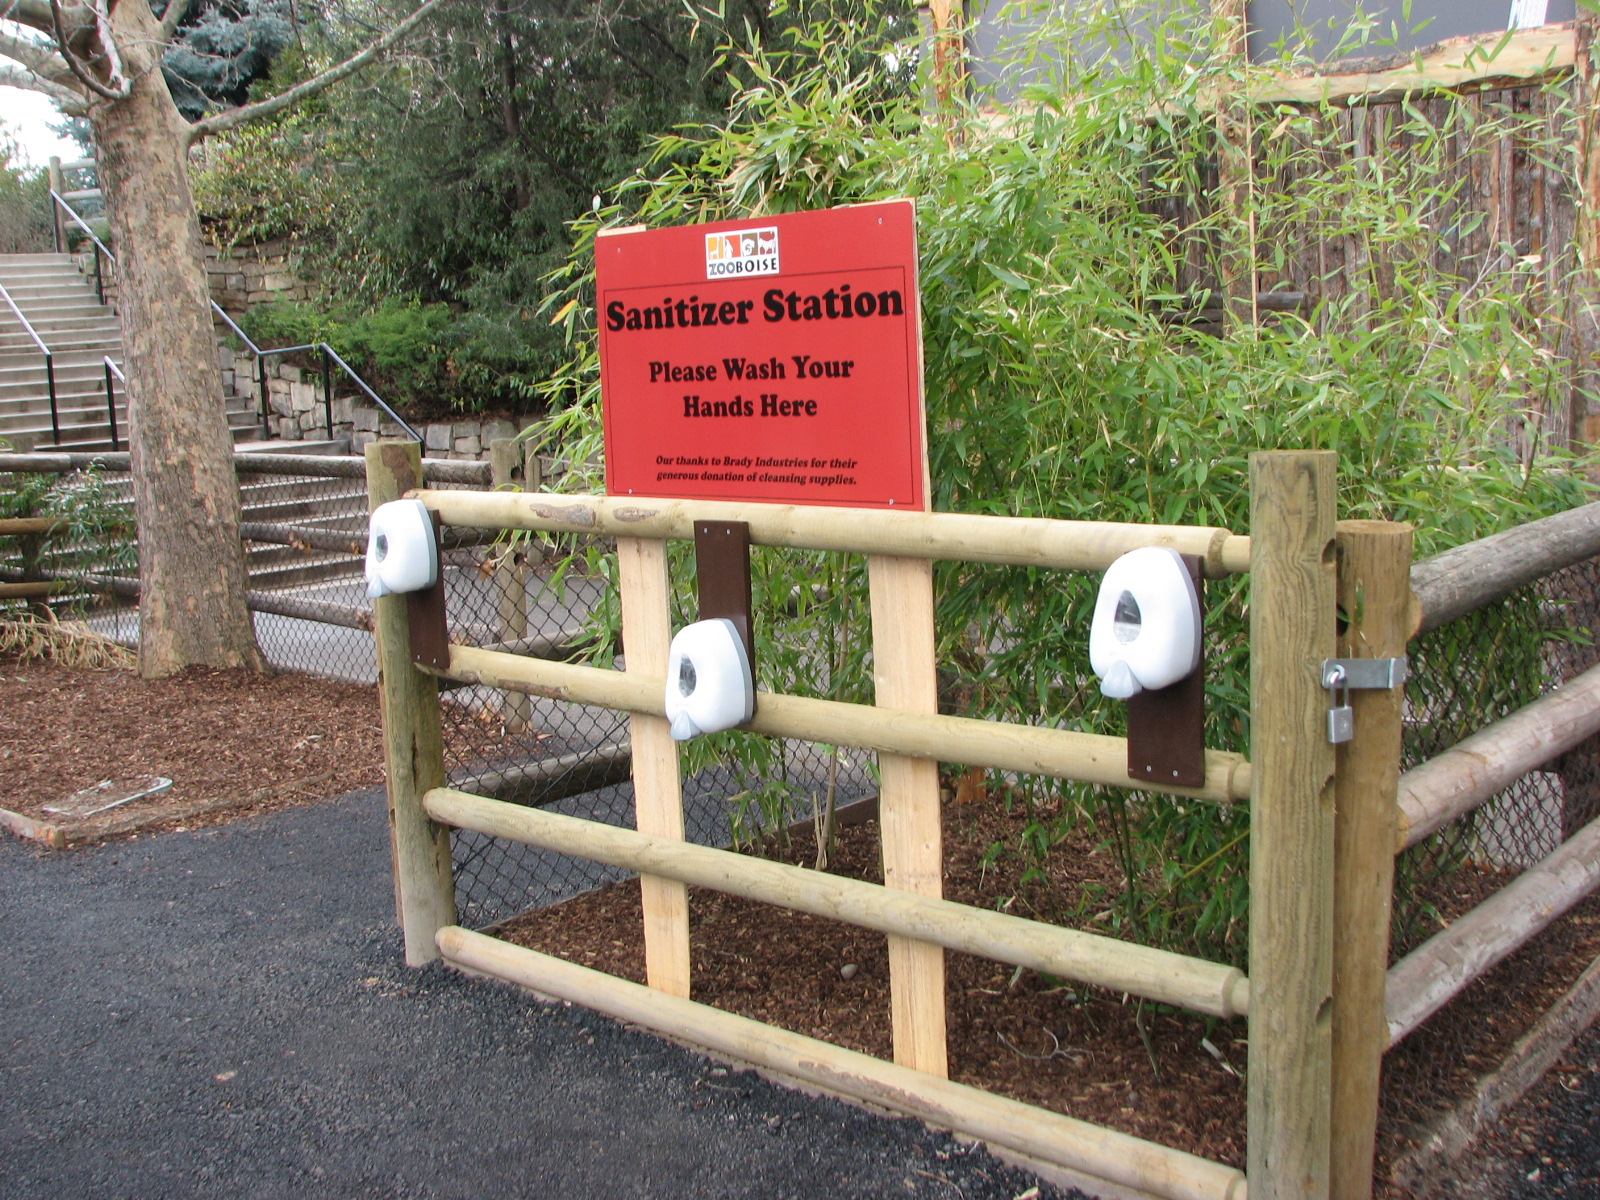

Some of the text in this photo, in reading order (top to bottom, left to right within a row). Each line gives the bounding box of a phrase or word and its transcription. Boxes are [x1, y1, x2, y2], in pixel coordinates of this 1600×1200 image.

[607, 284, 904, 332] Sanitizer Station
[649, 355, 855, 384] Please Wash Your
[683, 394, 818, 418] Hands Here
[656, 455, 858, 470] Our thanks to Brady Industries for their
[656, 471, 857, 487] generous donation of cleansing supplies.
